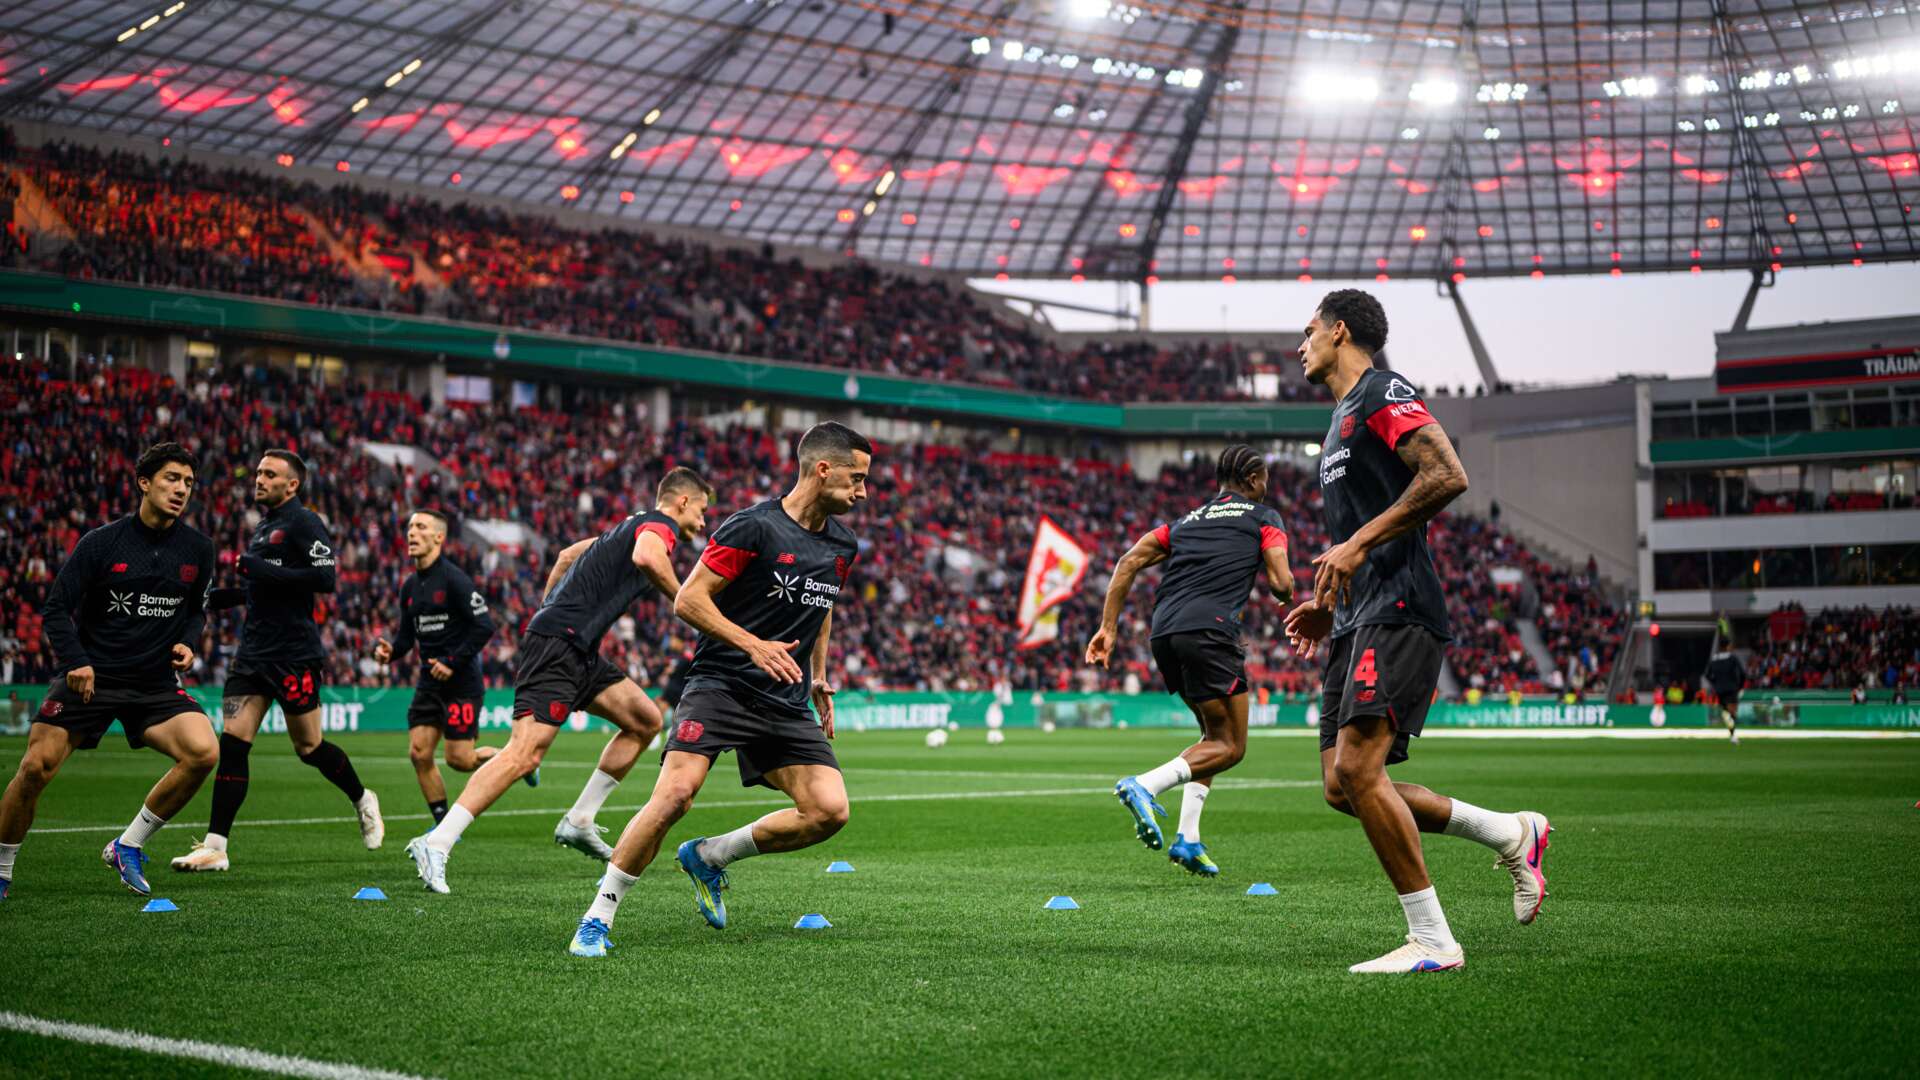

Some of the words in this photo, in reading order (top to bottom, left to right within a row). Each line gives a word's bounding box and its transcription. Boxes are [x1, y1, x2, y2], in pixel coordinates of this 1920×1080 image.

[804, 577, 840, 597] Barmen
[139, 593, 184, 606] Barmen
[800, 594, 834, 609] Gothae
[1353, 648, 1378, 687] 4
[282, 670, 314, 702] 24
[447, 703, 475, 726] 20
